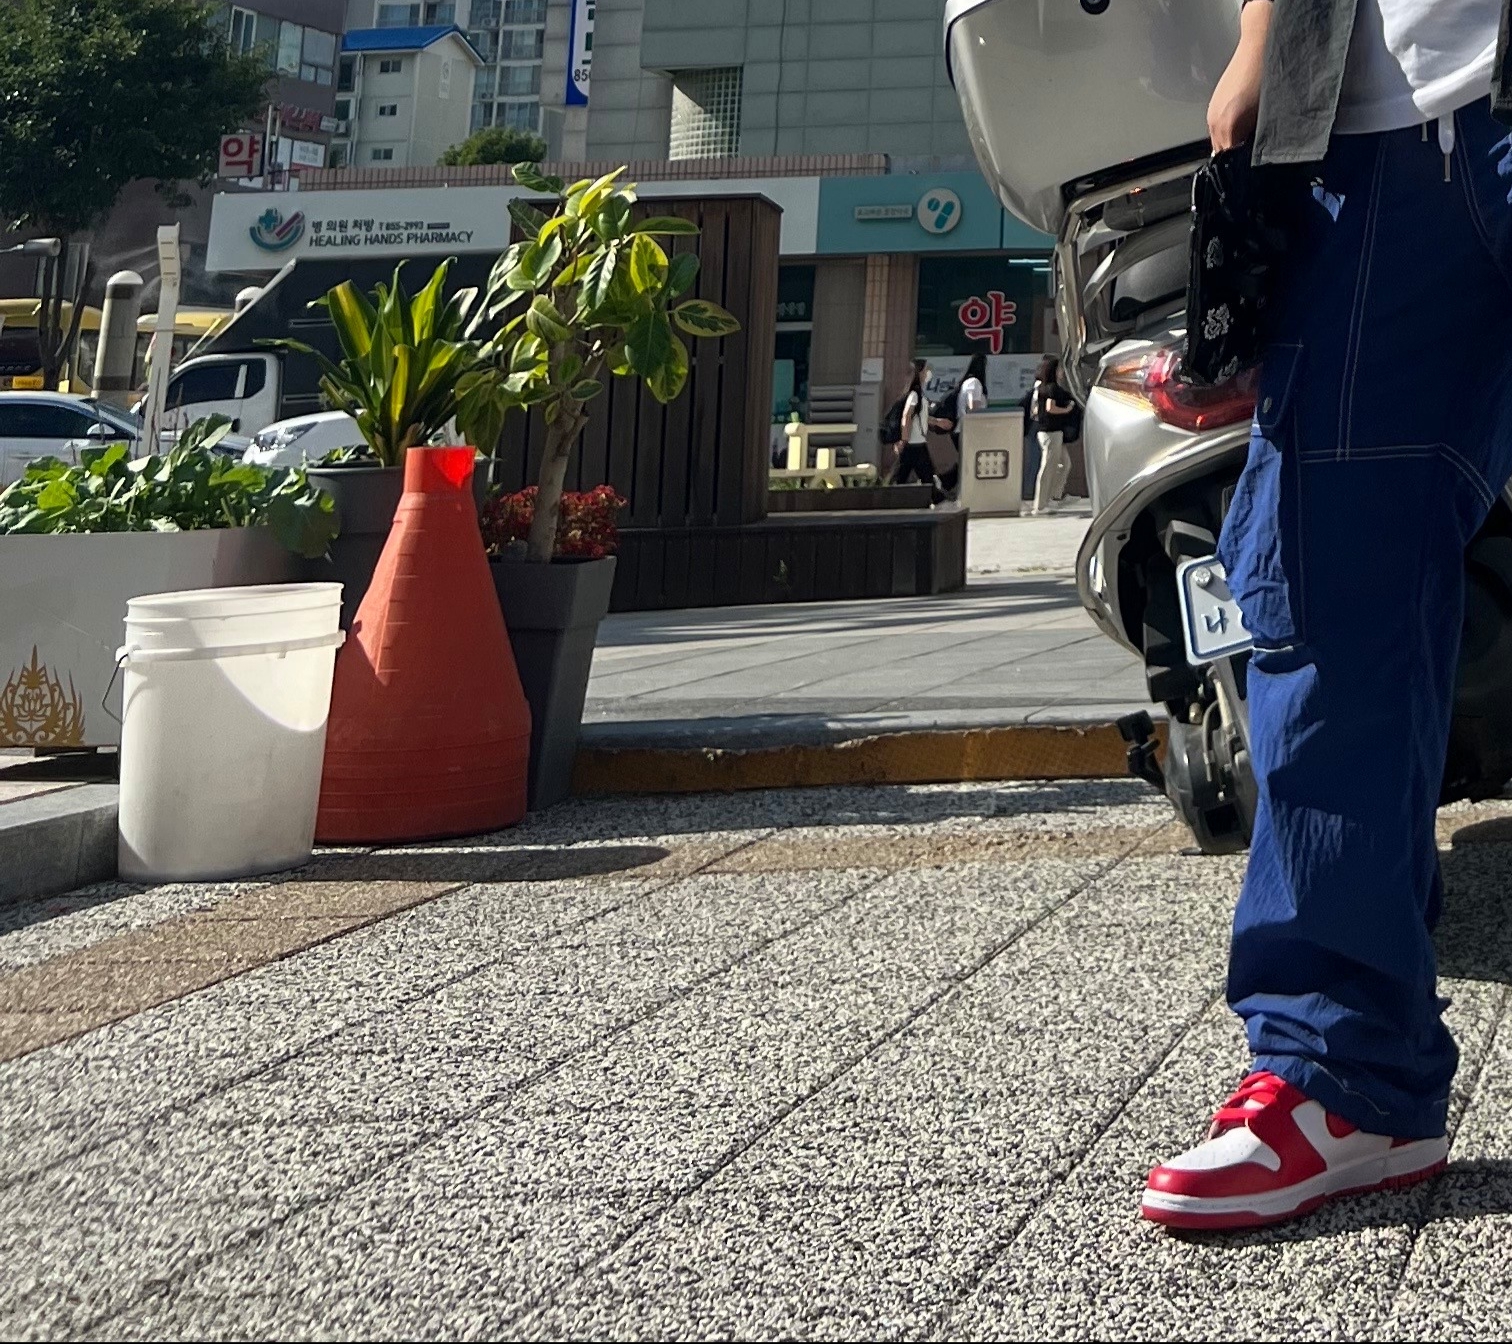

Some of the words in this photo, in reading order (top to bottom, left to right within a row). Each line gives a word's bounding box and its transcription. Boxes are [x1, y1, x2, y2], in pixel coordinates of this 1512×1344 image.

[222, 135, 260, 175] 약
[309, 233, 361, 247] HEALING
[364, 232, 404, 245] HANDS
[406, 230, 474, 245] PHARMACY
[959, 290, 1017, 354] 약
